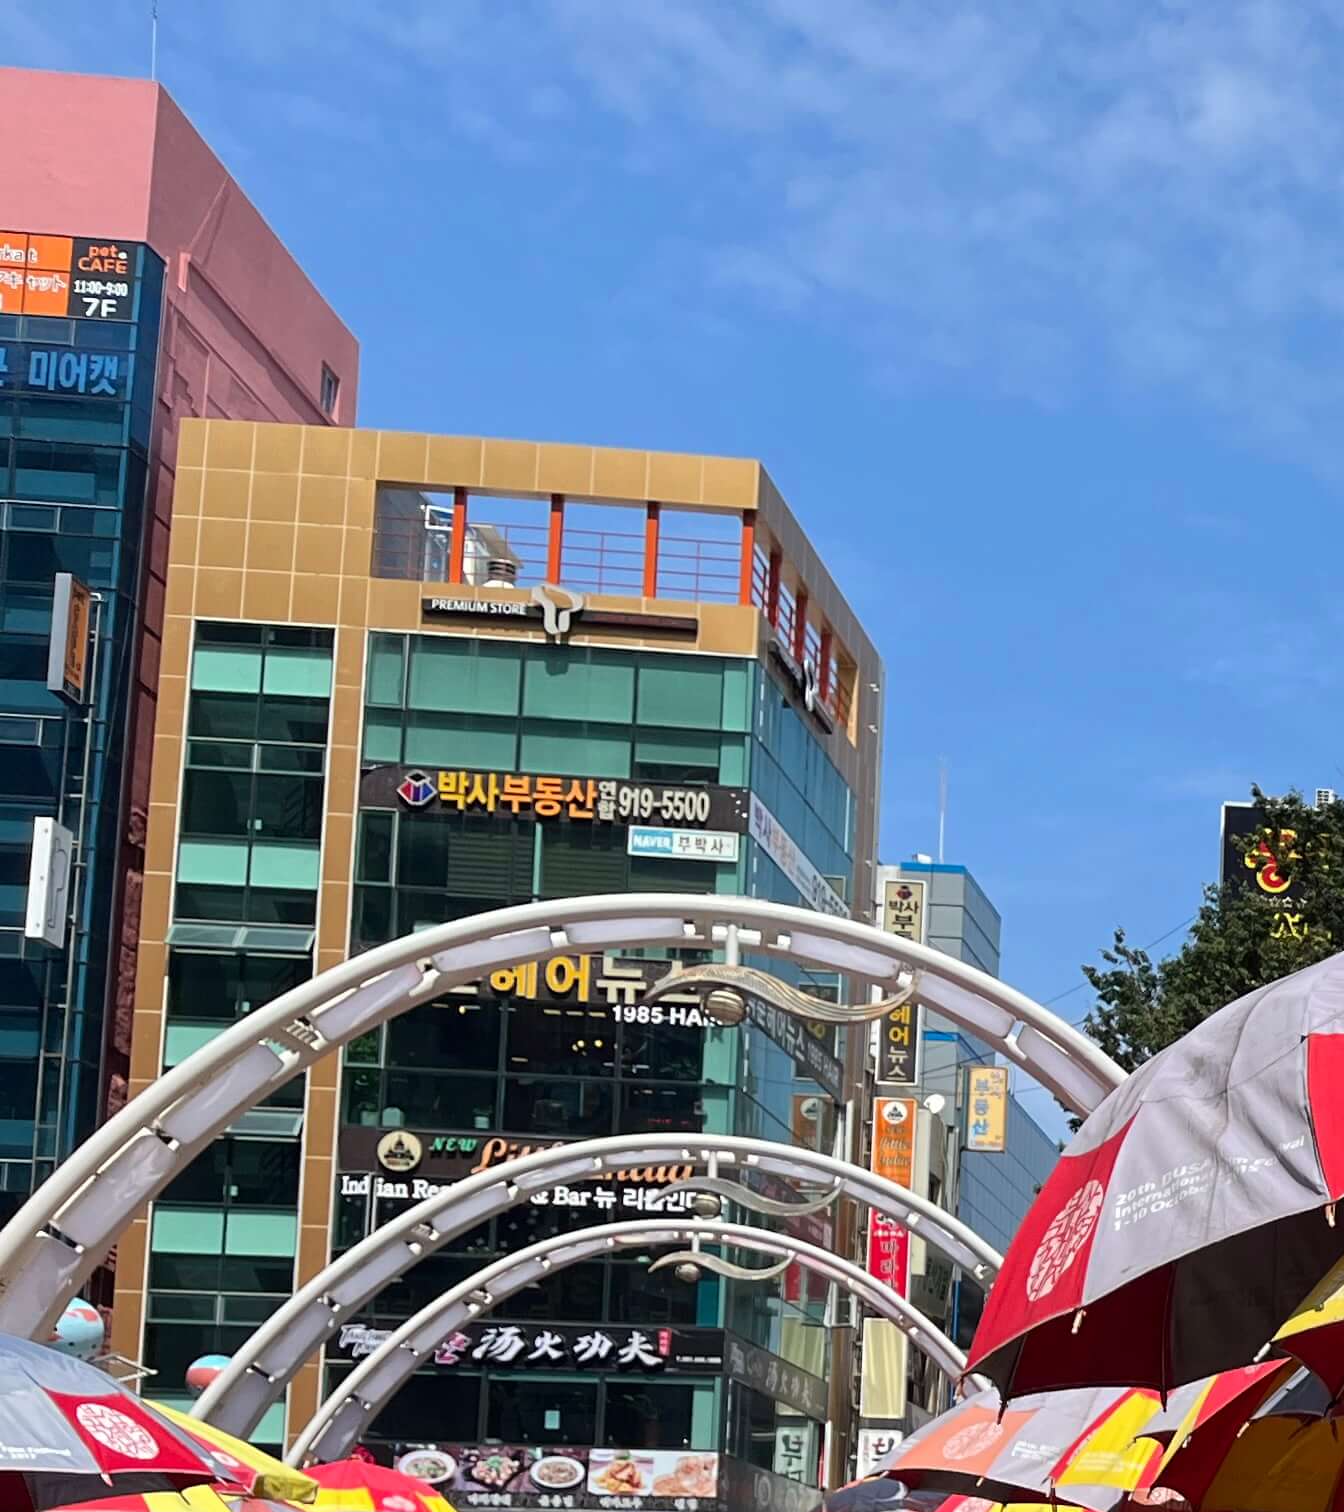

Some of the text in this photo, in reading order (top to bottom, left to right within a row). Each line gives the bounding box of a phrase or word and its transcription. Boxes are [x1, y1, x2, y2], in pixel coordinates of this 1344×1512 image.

[79, 257, 128, 274] CAFE
[83, 297, 117, 317] 7F
[29, 351, 118, 395] 미어캣
[431, 597, 526, 616] PREMIUM STORE
[438, 771, 597, 821] 박사부동산
[618, 786, 710, 822] 919-5500
[633, 834, 672, 849] NAVER
[612, 1004, 662, 1025] 1985
[429, 1137, 479, 1152] NEW
[552, 1186, 592, 1207] Bar
[593, 1187, 618, 1210] 뉴
